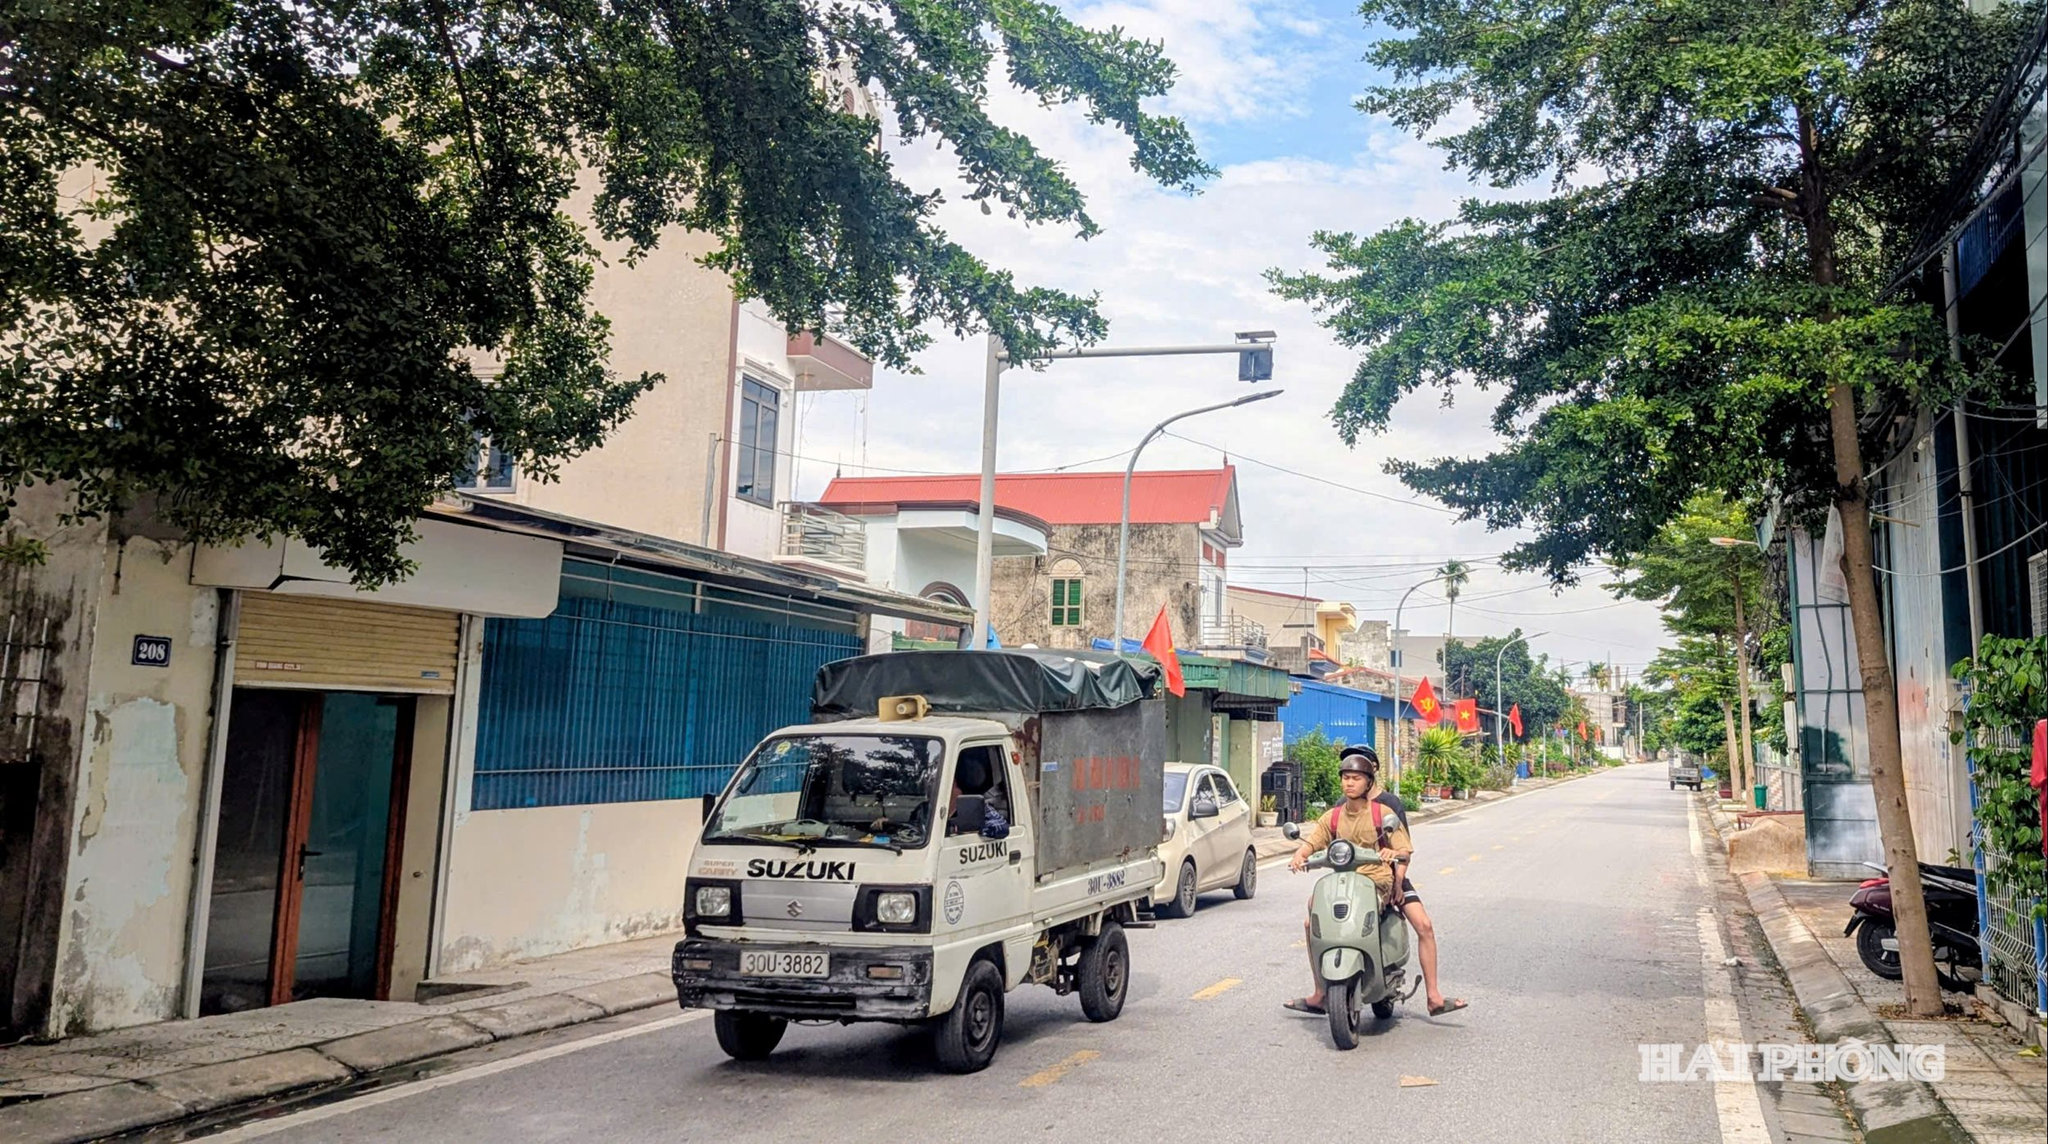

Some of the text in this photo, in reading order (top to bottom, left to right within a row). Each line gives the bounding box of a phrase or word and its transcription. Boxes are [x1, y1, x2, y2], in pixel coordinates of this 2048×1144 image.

[138, 642, 166, 661] 208
[959, 841, 1008, 865] SUZUKI
[747, 858, 856, 881] SUZUKI
